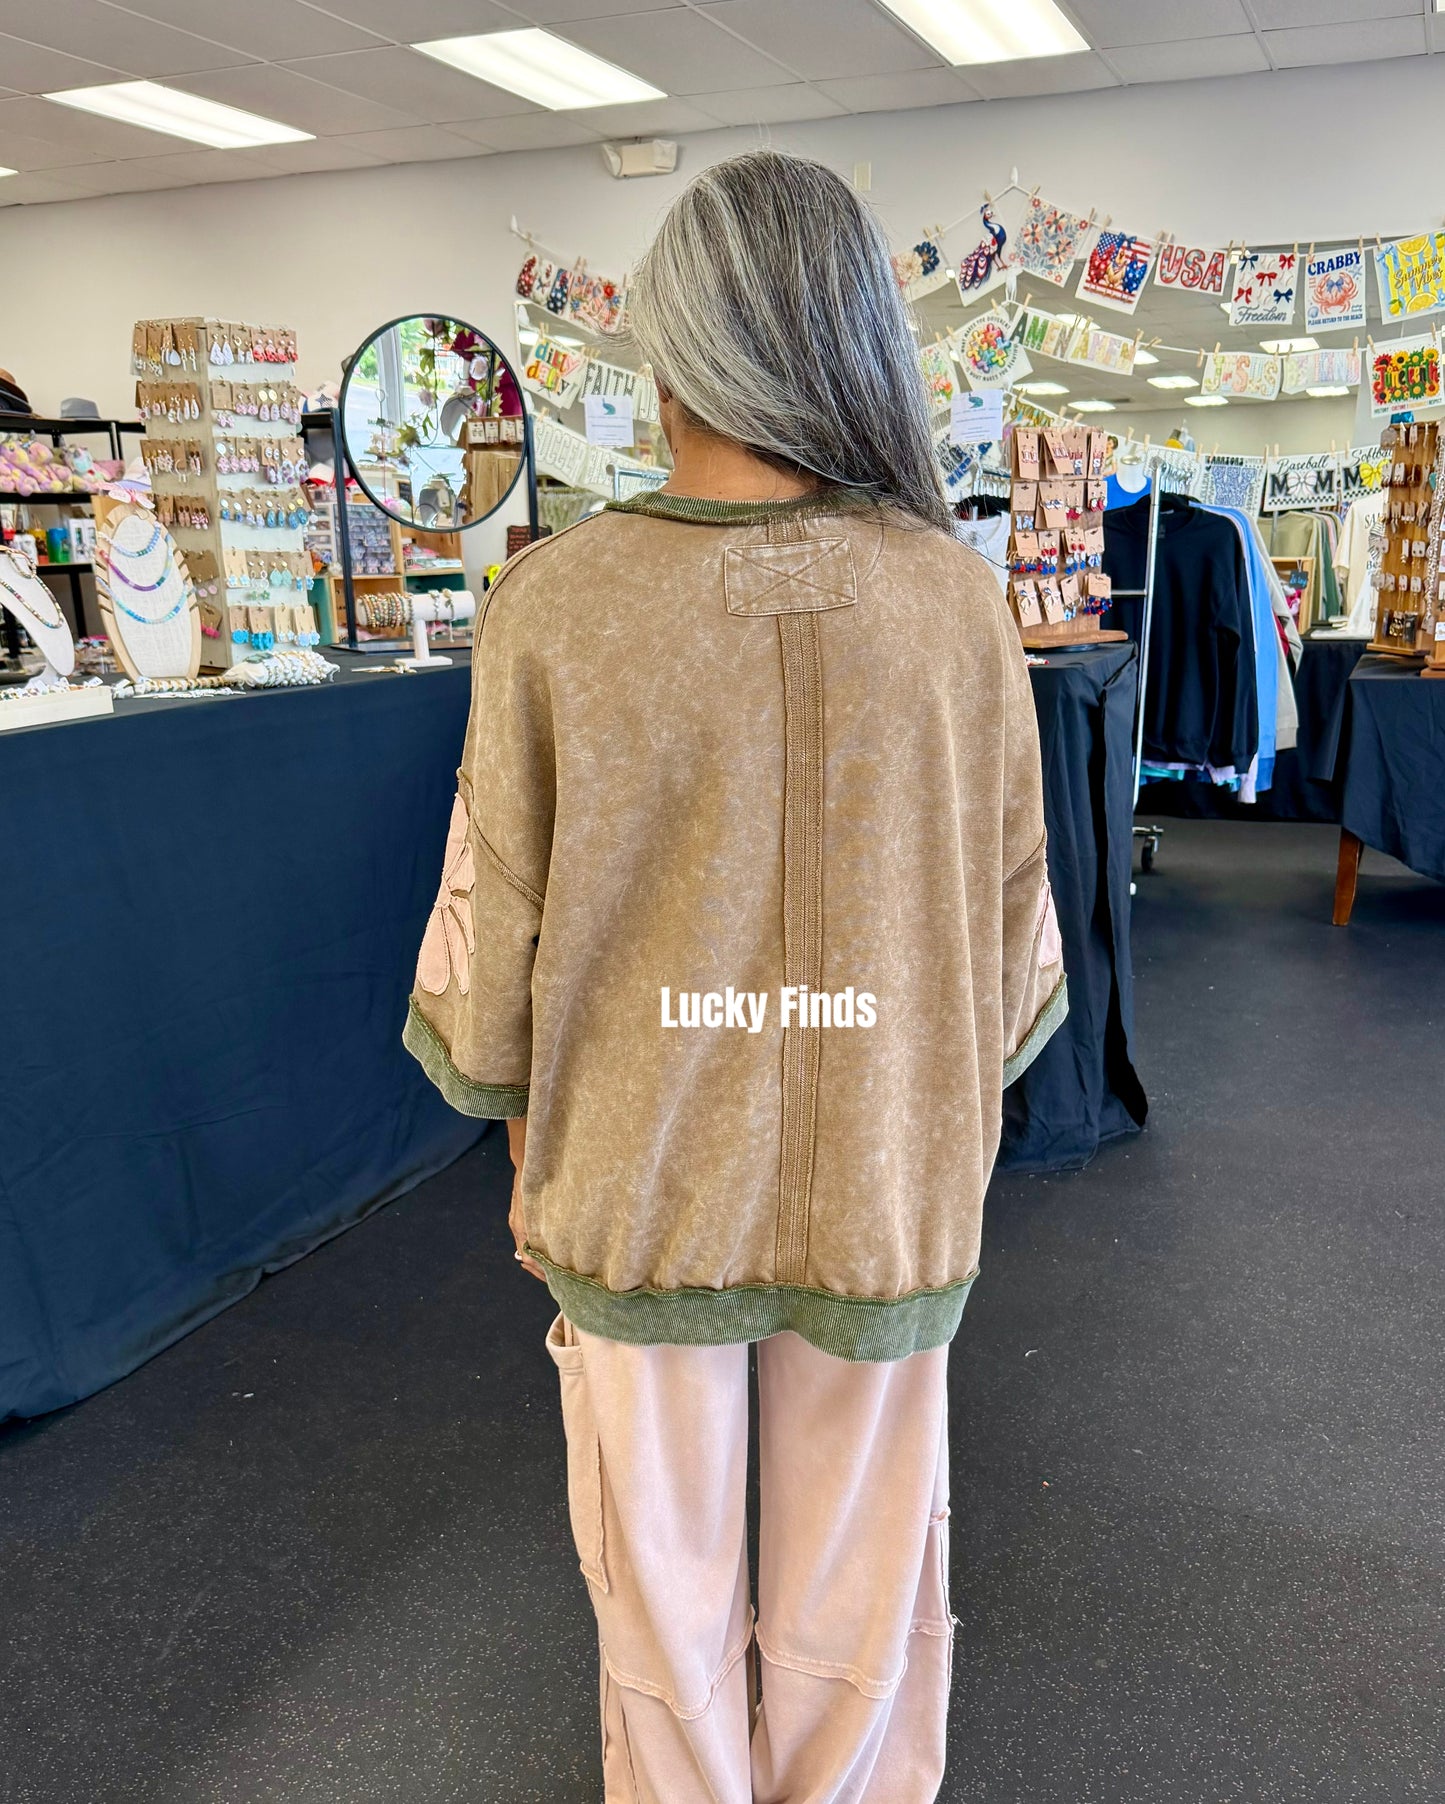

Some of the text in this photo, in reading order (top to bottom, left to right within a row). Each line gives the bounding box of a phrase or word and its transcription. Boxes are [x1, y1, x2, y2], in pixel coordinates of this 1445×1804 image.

[1159, 244, 1225, 293] USA
[1307, 250, 1362, 276] CRABBY
[1234, 305, 1287, 325] Freedom
[1009, 312, 1075, 359] AMEN
[581, 361, 636, 399] FAITH
[1204, 355, 1279, 397] JESUS
[1373, 359, 1440, 393] Juneteenth
[1277, 455, 1330, 475] Baseball
